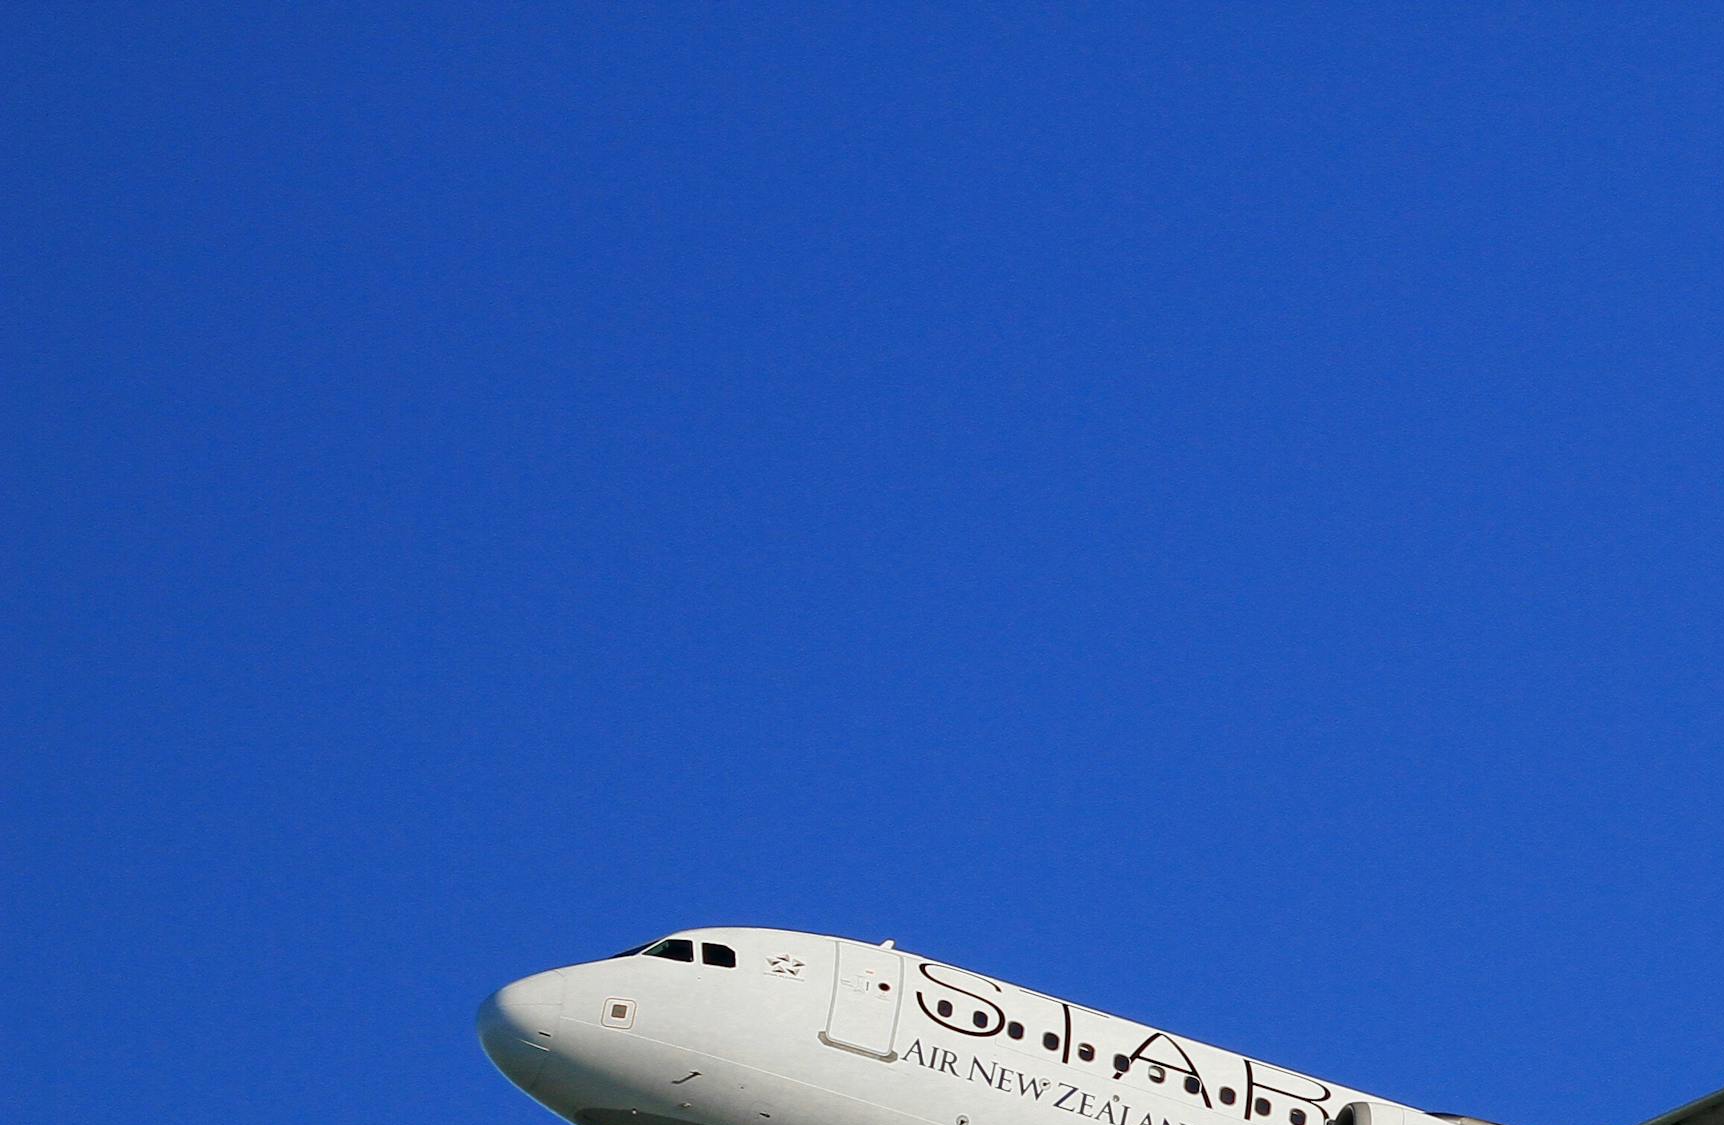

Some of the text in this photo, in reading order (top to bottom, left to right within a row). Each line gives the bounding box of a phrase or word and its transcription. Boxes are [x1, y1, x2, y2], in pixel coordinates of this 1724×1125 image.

[901, 1038, 960, 1078] AIR
[966, 1055, 1047, 1101] NEW
[916, 962, 1331, 1121] STAR
